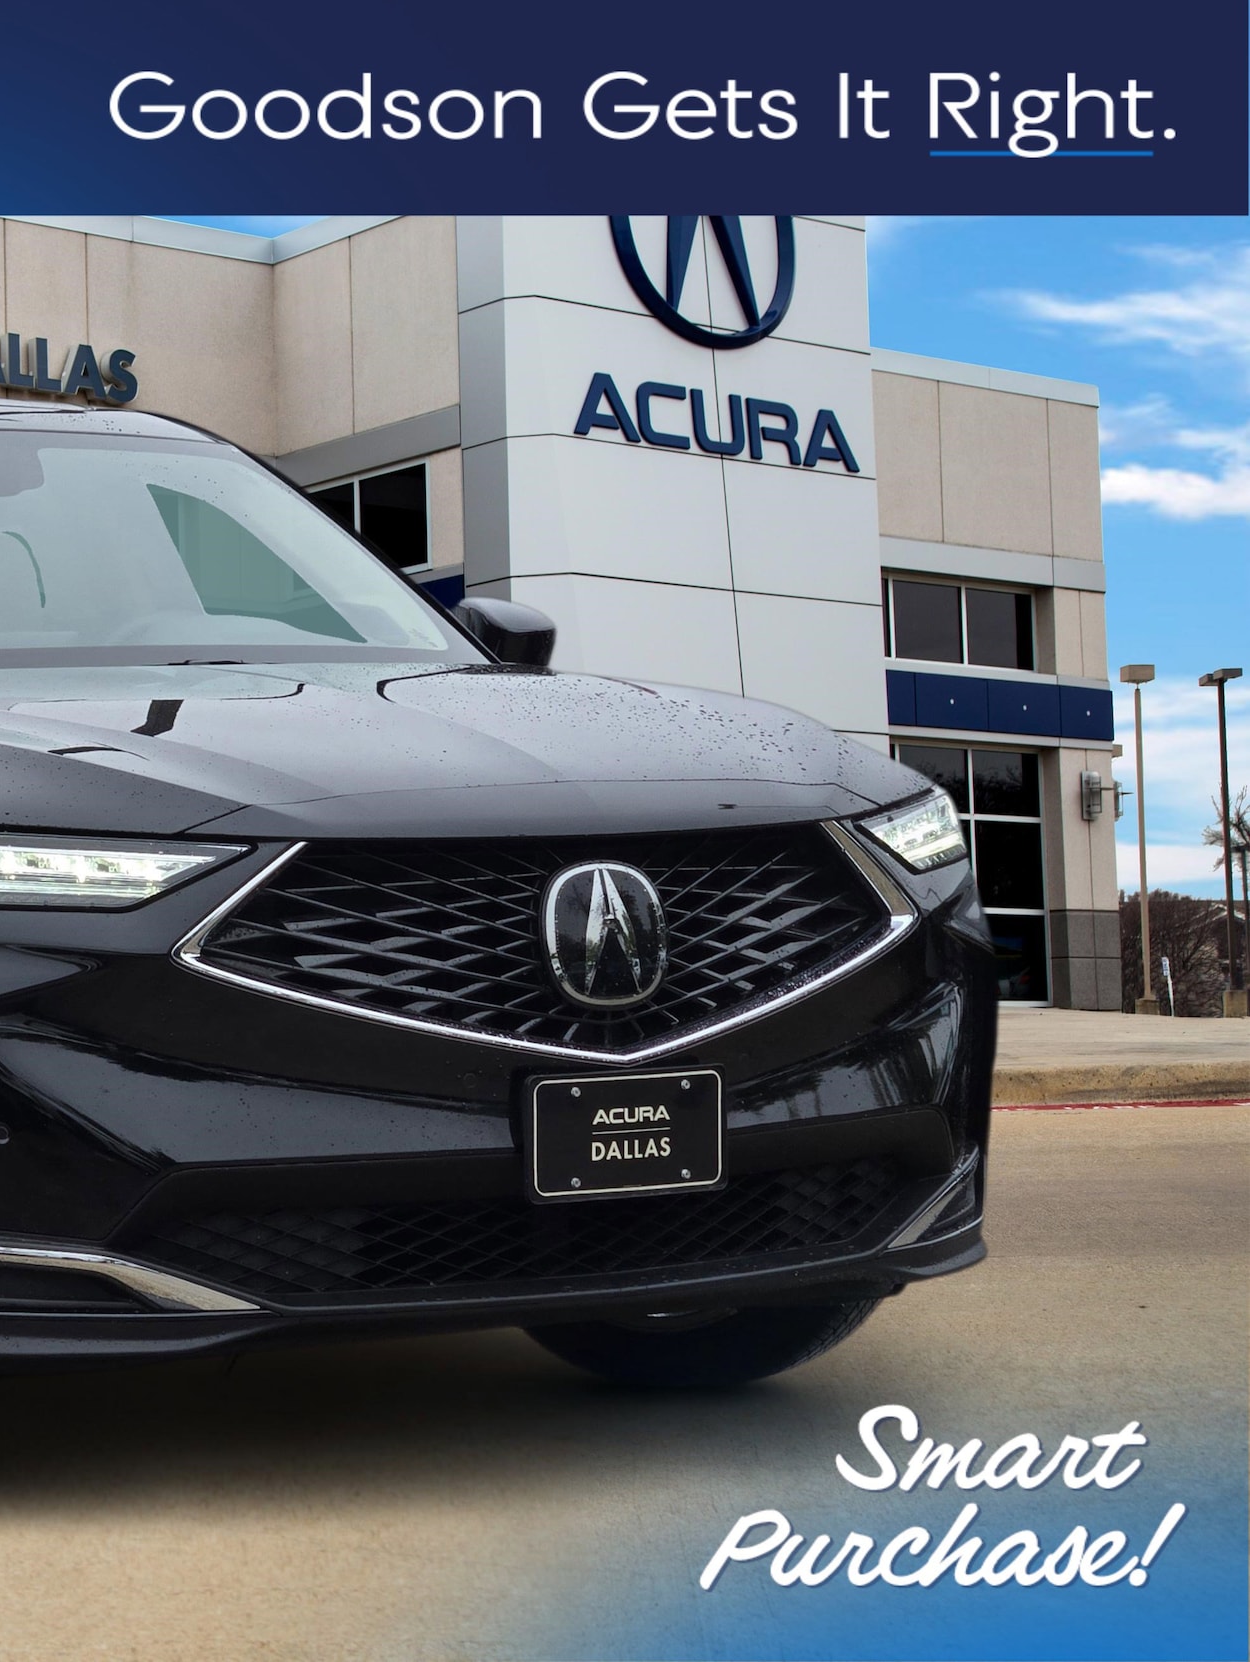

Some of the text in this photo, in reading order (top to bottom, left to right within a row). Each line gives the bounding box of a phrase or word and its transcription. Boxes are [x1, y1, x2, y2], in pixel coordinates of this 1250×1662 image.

[575, 372, 860, 473] ACURA
[592, 1104, 671, 1126] ACURA
[591, 1136, 672, 1162] DALLAS
